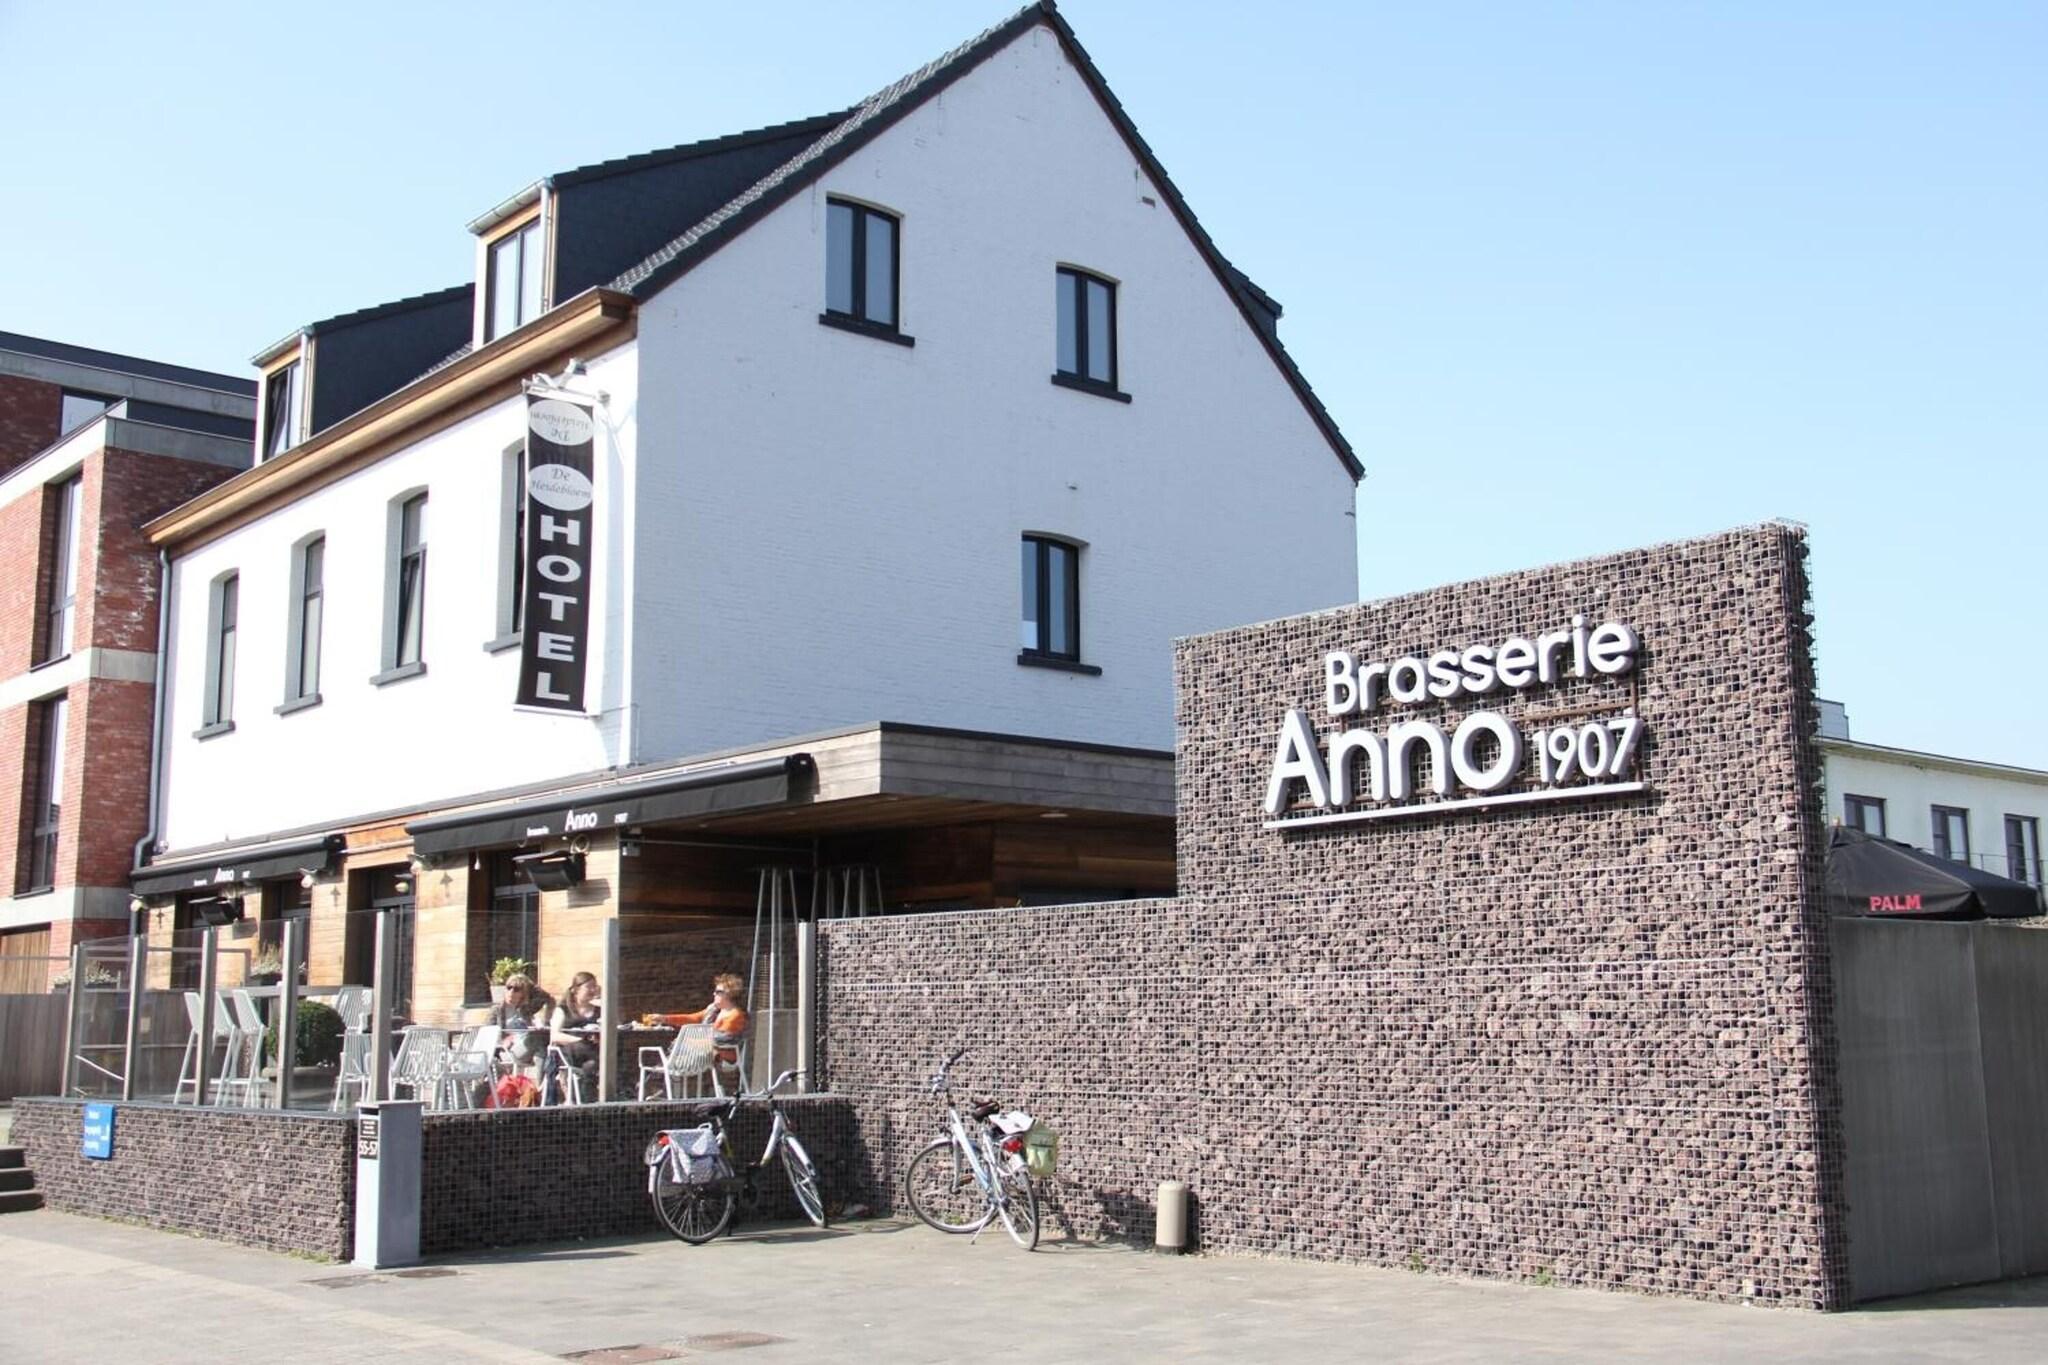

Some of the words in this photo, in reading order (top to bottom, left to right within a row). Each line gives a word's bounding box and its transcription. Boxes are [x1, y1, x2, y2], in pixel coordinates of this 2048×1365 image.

[551, 468, 570, 481] De
[536, 514, 581, 701] HOTEL
[1326, 614, 1640, 716] Brasserie
[1265, 708, 1523, 814] Anno
[1532, 717, 1644, 784] 1907
[564, 809, 598, 832] Anno
[1869, 894, 1922, 911] PALM
